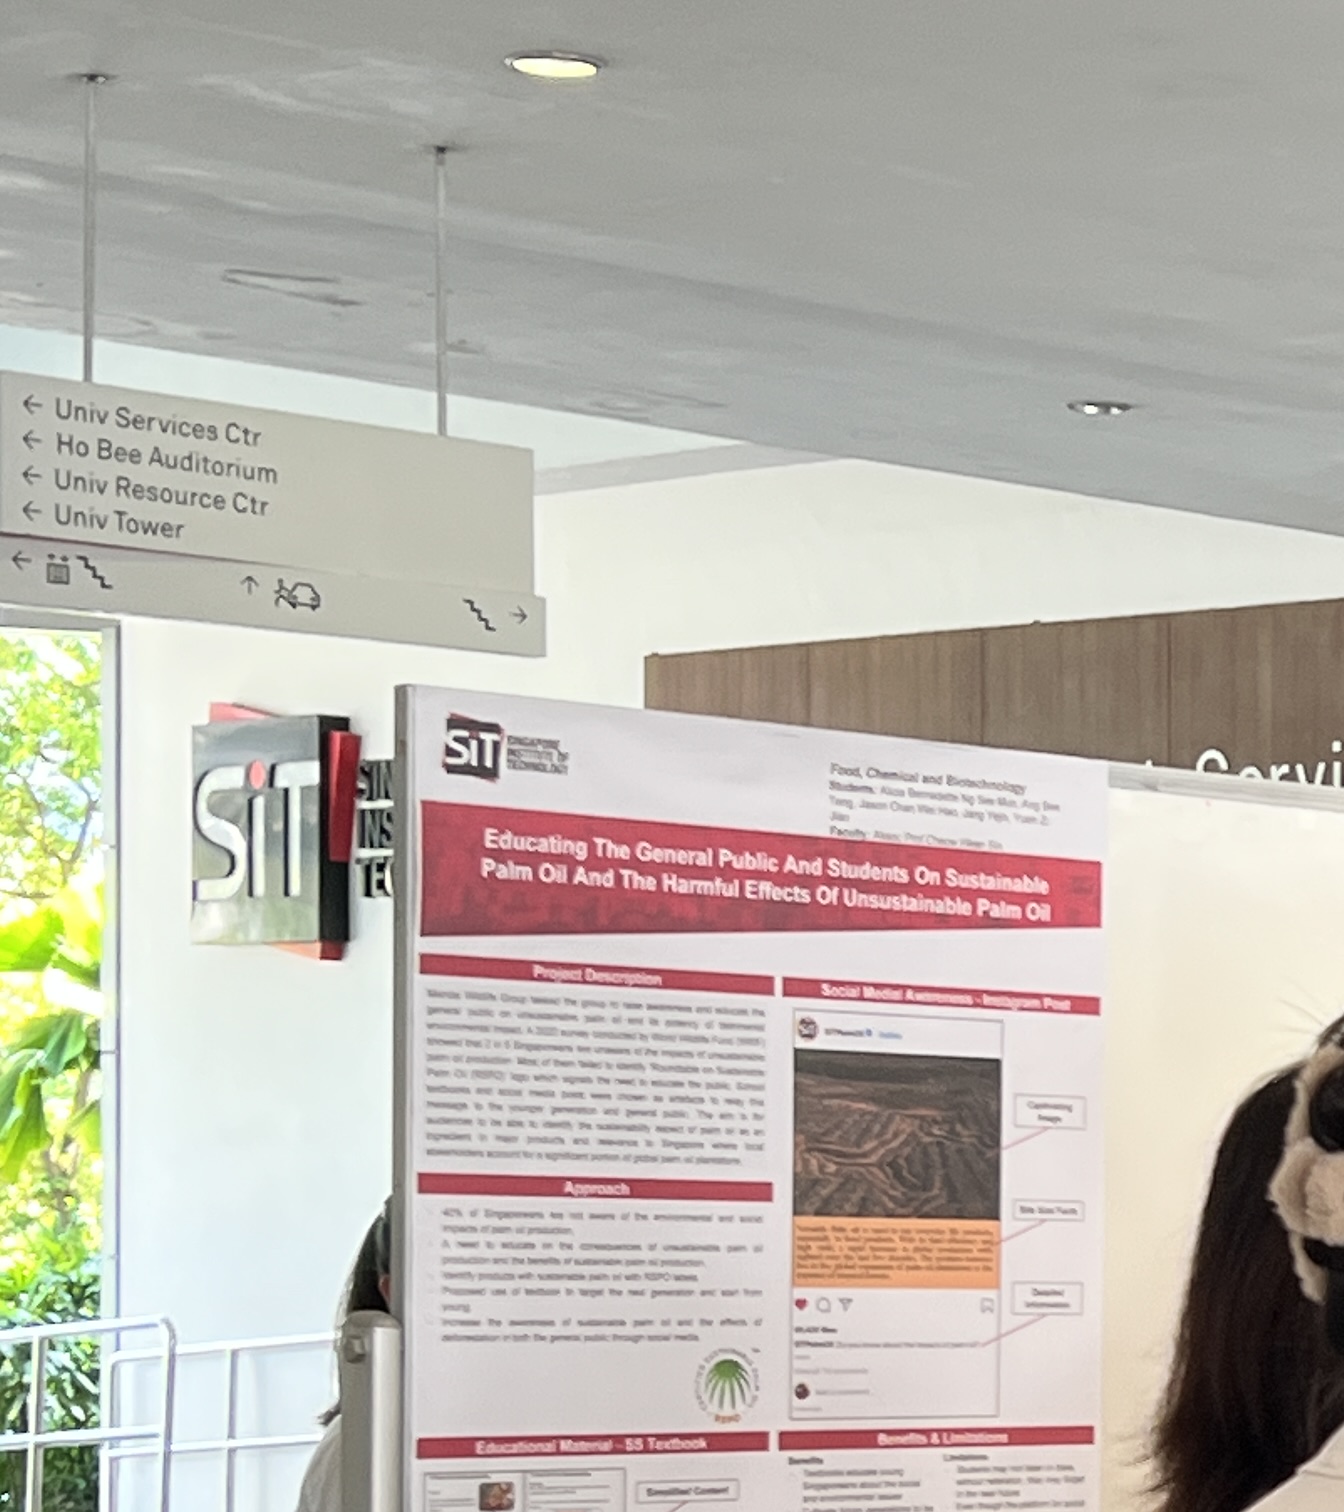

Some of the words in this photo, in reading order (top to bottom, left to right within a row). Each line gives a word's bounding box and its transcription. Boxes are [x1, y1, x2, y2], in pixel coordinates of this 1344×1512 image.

[55, 397, 108, 426] Univ
[115, 407, 218, 443] Services
[225, 423, 261, 447] Ctr
[56, 433, 89, 459] Ho
[97, 440, 142, 466] Bee
[148, 446, 278, 484] Auditorium
[55, 468, 108, 496] Univ
[115, 476, 226, 512] Resource
[233, 493, 269, 517] Ctr
[55, 504, 108, 532] Univ
[114, 511, 184, 540] Tower
[484, 828, 588, 861] Educating
[593, 837, 630, 861] The
[636, 844, 712, 867] General
[718, 848, 779, 873] Public
[784, 854, 822, 877] And
[827, 858, 909, 884] Students
[914, 866, 941, 886] On
[945, 868, 1050, 895] Sustainable
[481, 858, 533, 882] Palm
[538, 863, 568, 884] Oil
[573, 866, 615, 888] And
[619, 869, 657, 891] The
[662, 873, 739, 899] Harmful
[745, 880, 811, 905] Effects
[816, 885, 838, 905] Of
[844, 888, 972, 917] Unsustainable
[977, 898, 1022, 920] Palm
[1025, 902, 1051, 922] Oil
[563, 1180, 631, 1198] Approach
